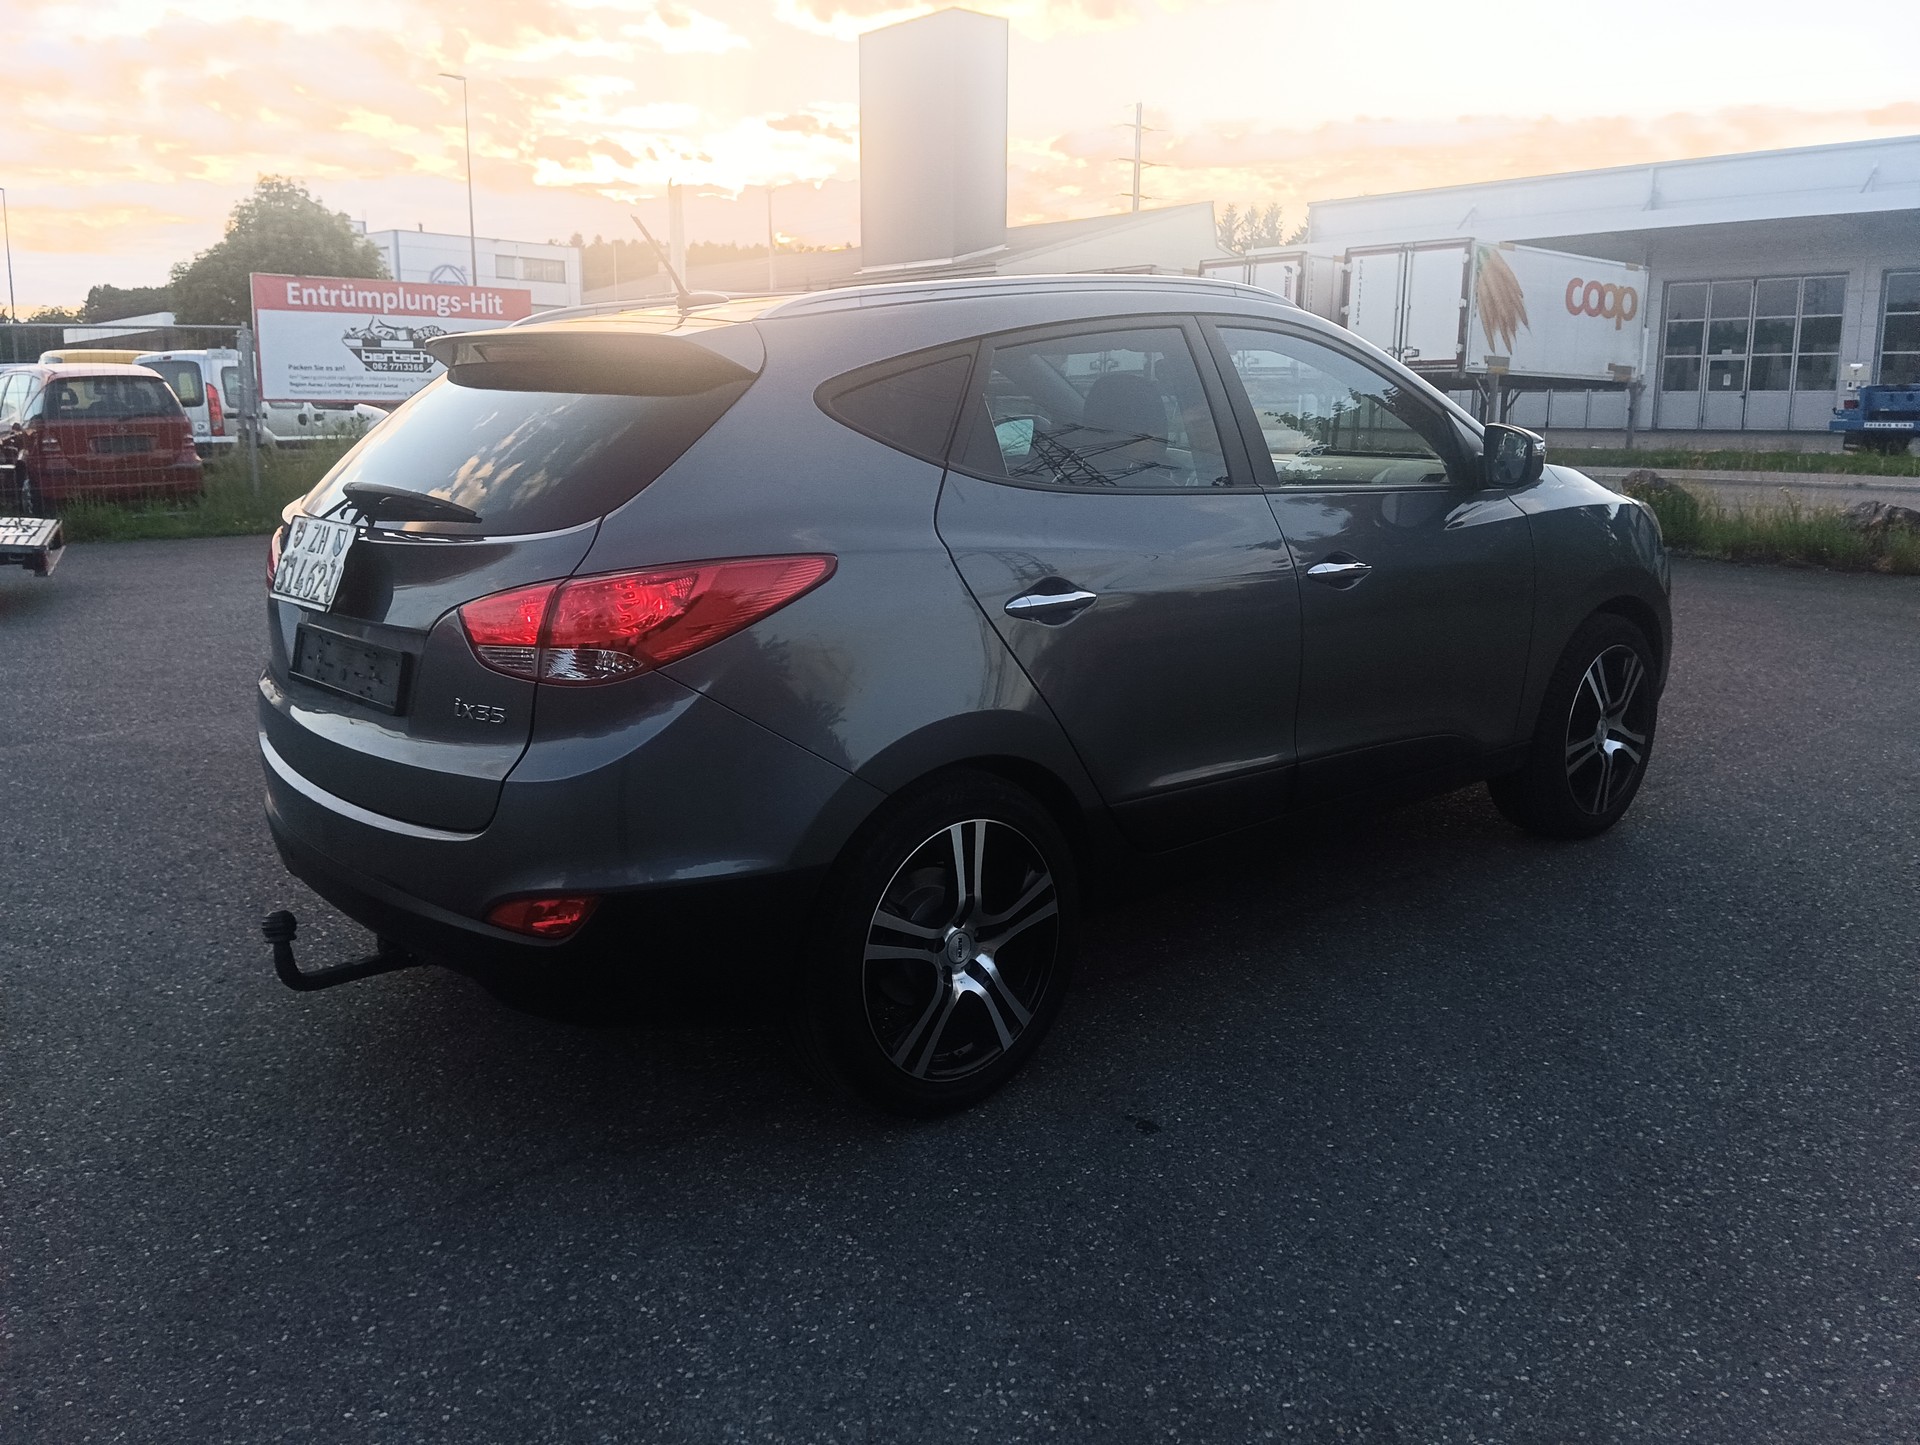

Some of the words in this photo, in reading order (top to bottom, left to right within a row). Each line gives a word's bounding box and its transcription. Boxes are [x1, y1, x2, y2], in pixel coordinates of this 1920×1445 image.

[286, 282, 503, 317] Entrümplungs-Hit
[1565, 277, 1638, 331] coop
[361, 350, 434, 363] bertschi
[307, 524, 331, 555] ZH
[454, 697, 506, 723] ix35
